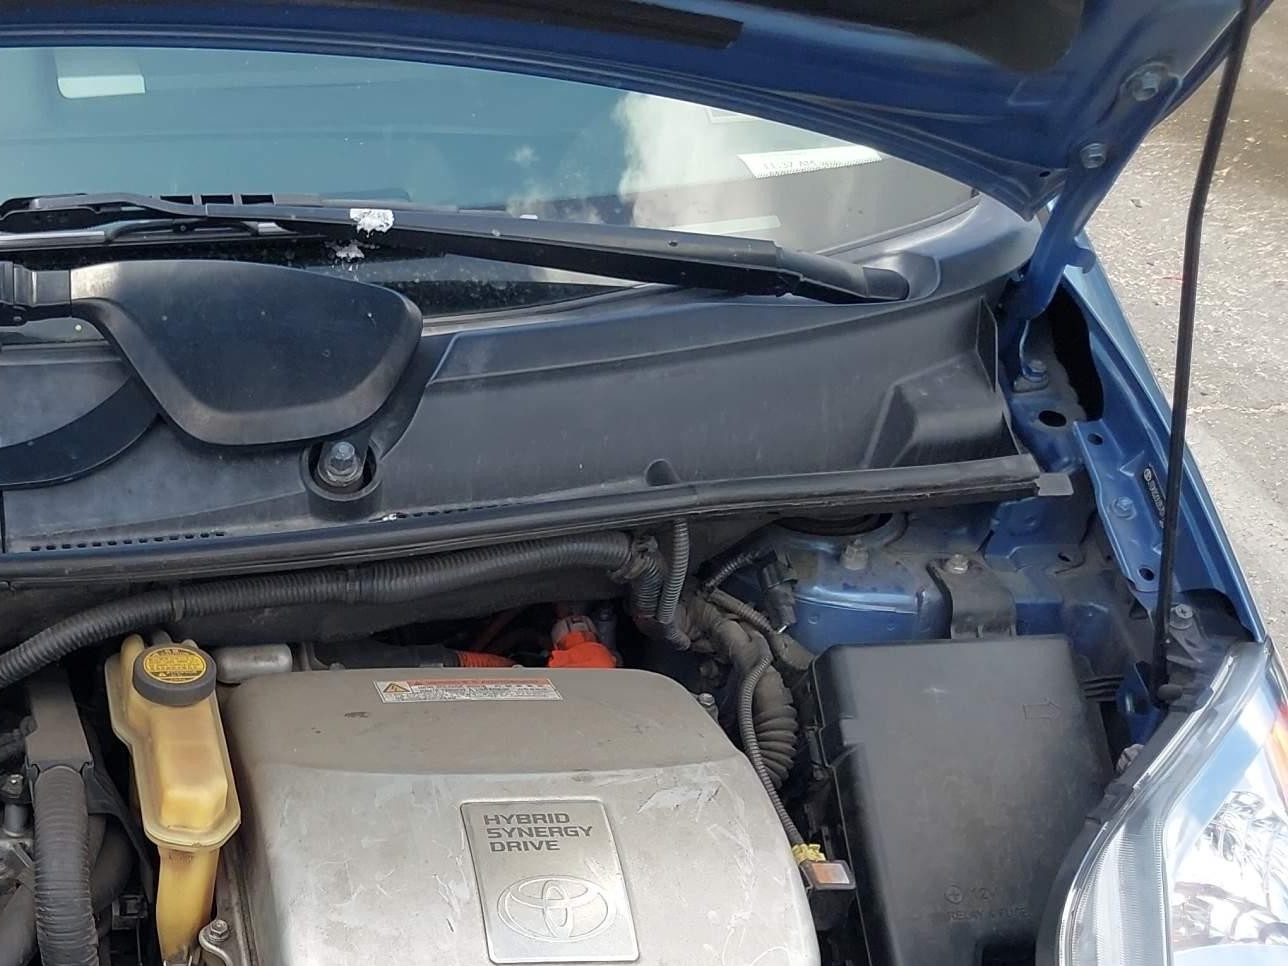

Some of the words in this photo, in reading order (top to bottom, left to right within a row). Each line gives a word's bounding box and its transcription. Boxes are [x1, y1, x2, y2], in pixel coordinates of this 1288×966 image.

[483, 812, 570, 825] HYBRID
[487, 826, 592, 839] SYNERGY
[490, 840, 561, 852] DRIVE
